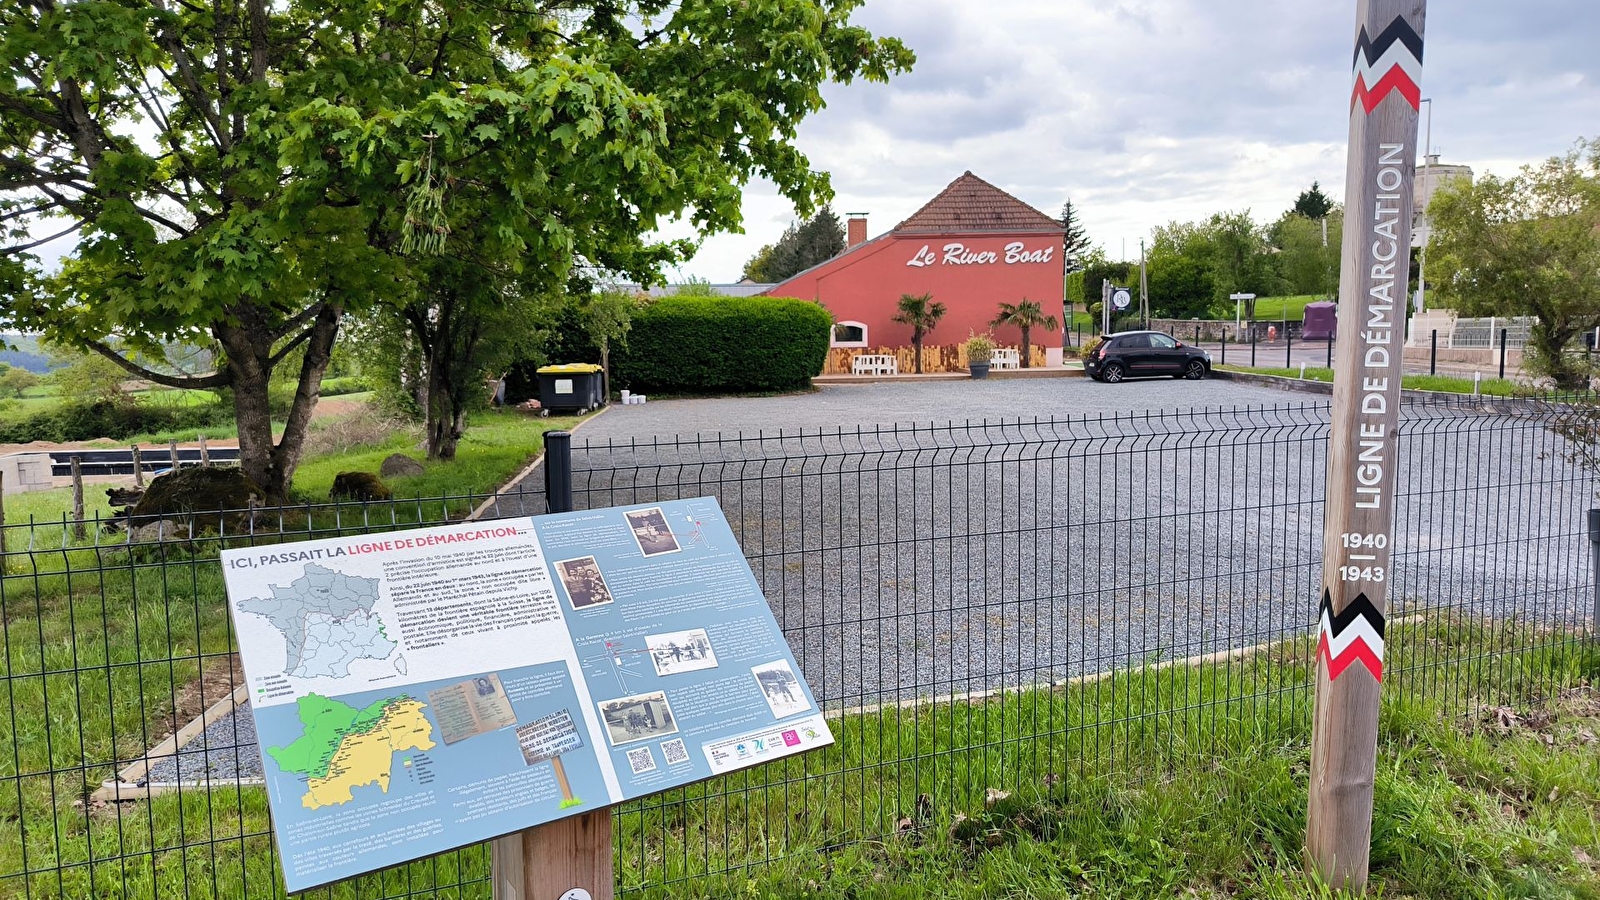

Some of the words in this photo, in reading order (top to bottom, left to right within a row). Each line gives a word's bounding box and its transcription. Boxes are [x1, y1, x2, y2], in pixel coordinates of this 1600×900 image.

[906, 245, 936, 267] Le
[942, 243, 998, 265] River
[1004, 241, 1054, 264] Boat
[1360, 142, 1404, 368] DÉMARCATION
[1361, 376, 1388, 414] DE
[1355, 423, 1385, 509] LIGNE
[230, 557, 258, 569] ICI,
[259, 549, 324, 566] PASSAIT
[326, 546, 347, 558] LA
[347, 541, 393, 555] LIGNE
[394, 539, 414, 549] DE
[415, 527, 527, 547] DÉMARCATION...
[1341, 532, 1387, 549] 1940
[1339, 565, 1384, 582] 1943
